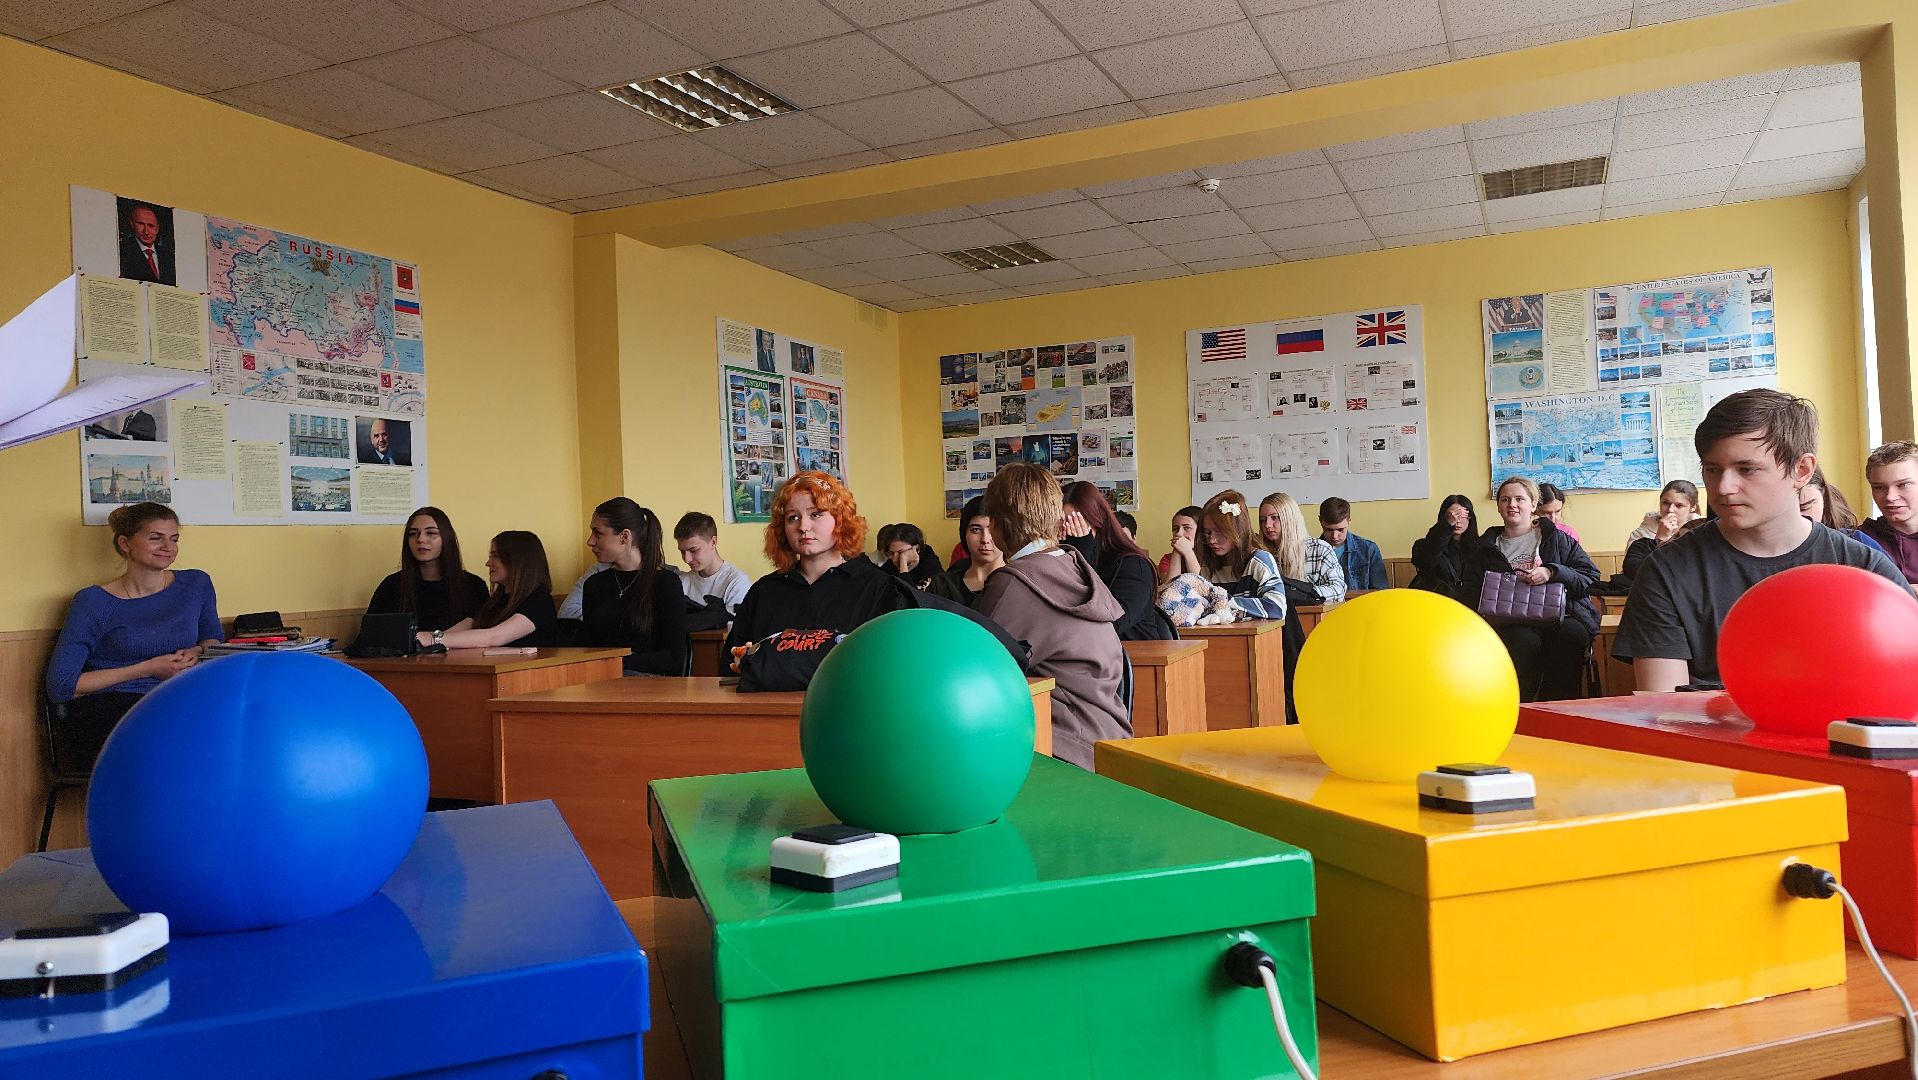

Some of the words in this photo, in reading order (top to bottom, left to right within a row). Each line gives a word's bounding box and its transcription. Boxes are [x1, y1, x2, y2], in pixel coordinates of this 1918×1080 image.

[289, 240, 354, 265] RUSSIA
[1636, 282, 1664, 291] UNITED
[1666, 279, 1693, 287] STATES
[1706, 273, 1742, 283] AMERICA
[1525, 396, 1594, 409] WASHINGTON
[1598, 394, 1618, 402] D.C.
[776, 639, 826, 651] COURT
